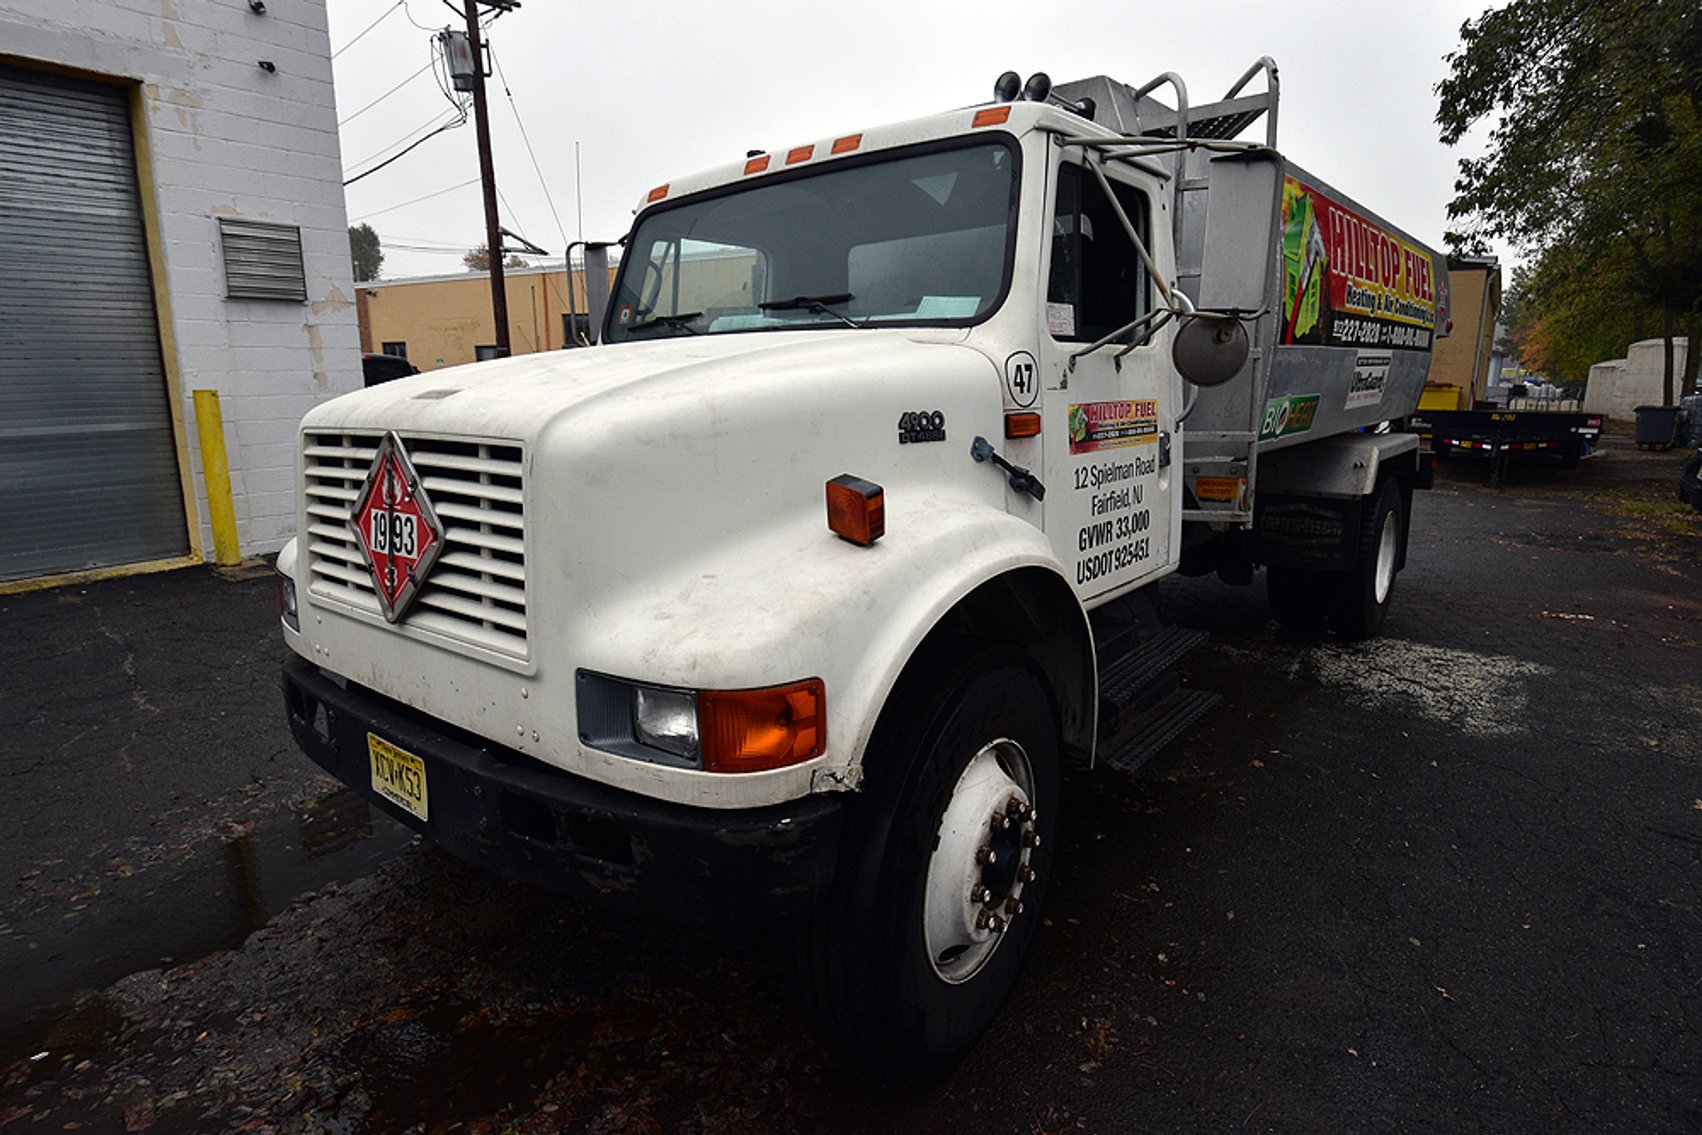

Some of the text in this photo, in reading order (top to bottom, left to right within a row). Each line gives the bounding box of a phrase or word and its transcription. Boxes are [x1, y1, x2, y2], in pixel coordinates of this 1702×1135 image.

[1329, 207, 1434, 302] HILLTOP FUEL
[1014, 364, 1033, 394] 47
[899, 410, 945, 432] 4900
[1090, 401, 1155, 423] HILLTOP FUEL
[1074, 455, 1155, 490] 12 Spielman Road
[1092, 484, 1143, 516] Fairfield, NJ
[373, 512, 415, 556] 1993
[1079, 509, 1150, 552] GVWR 33,000
[1077, 537, 1150, 584] USDOT 925451
